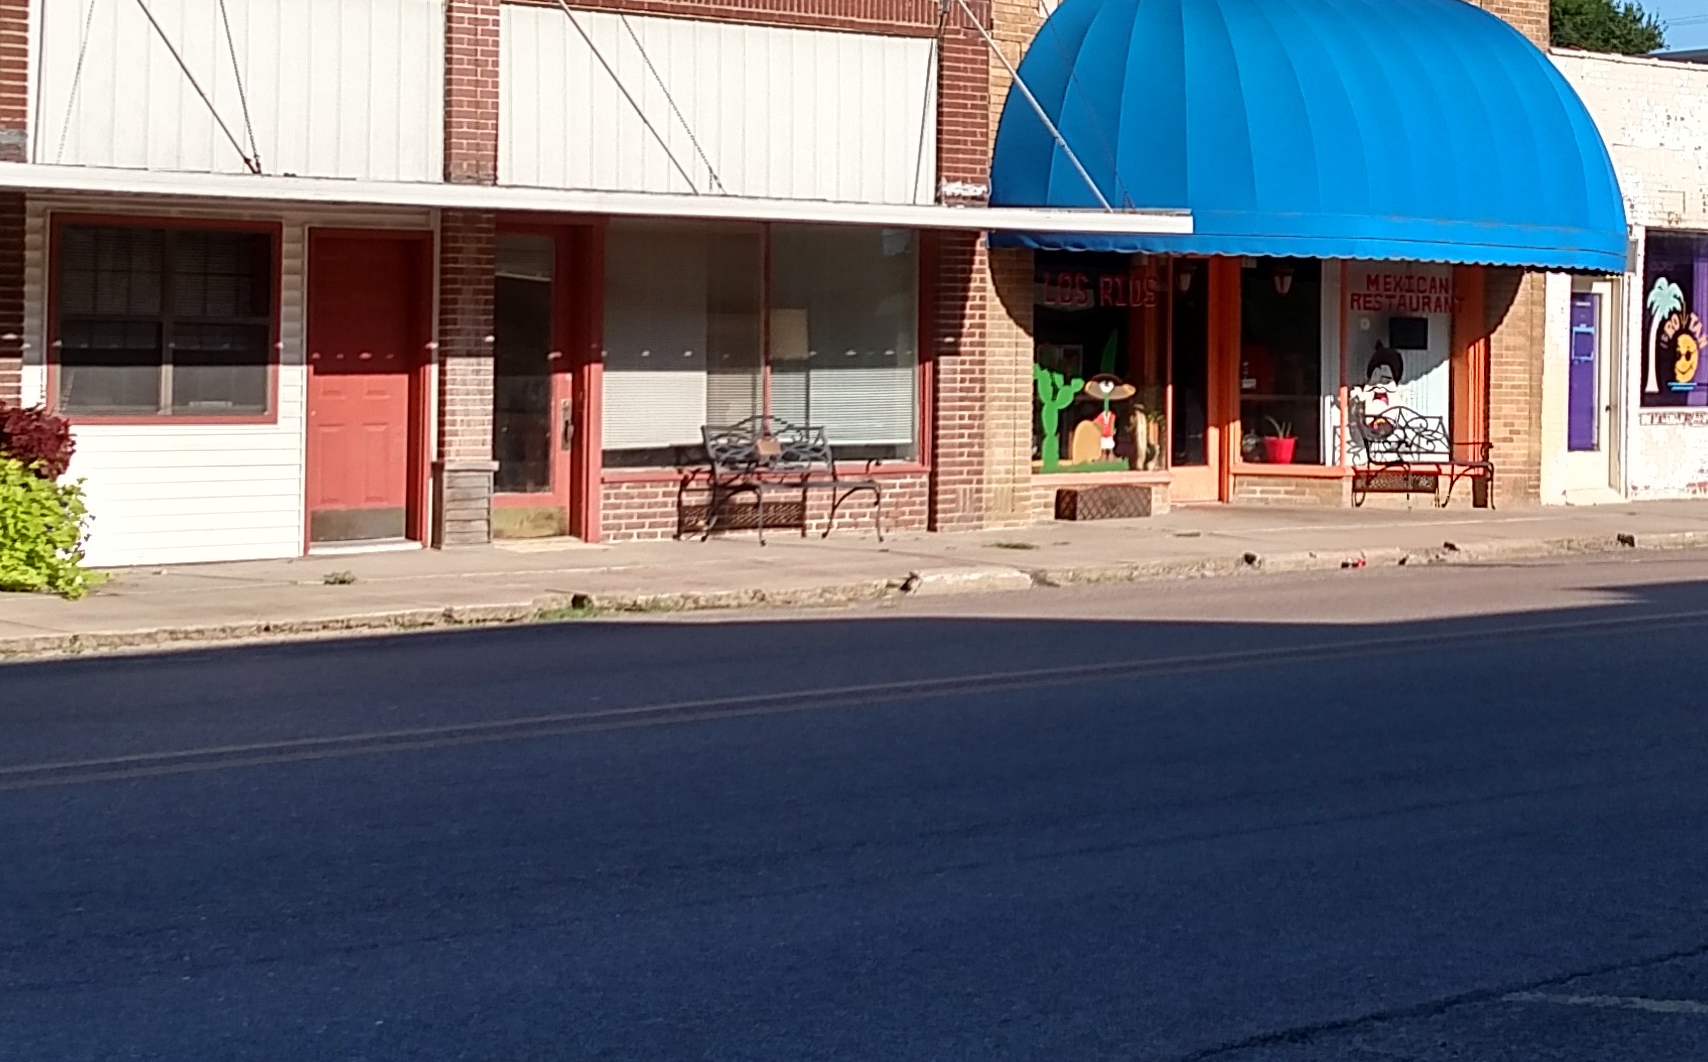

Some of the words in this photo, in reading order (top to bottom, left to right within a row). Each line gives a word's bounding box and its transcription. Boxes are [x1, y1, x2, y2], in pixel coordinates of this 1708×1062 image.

[1043, 272, 1089, 307] LOS
[1100, 275, 1157, 307] RIOS
[1366, 274, 1449, 295] MEXICAN
[1350, 292, 1465, 314] RESTAURANT
